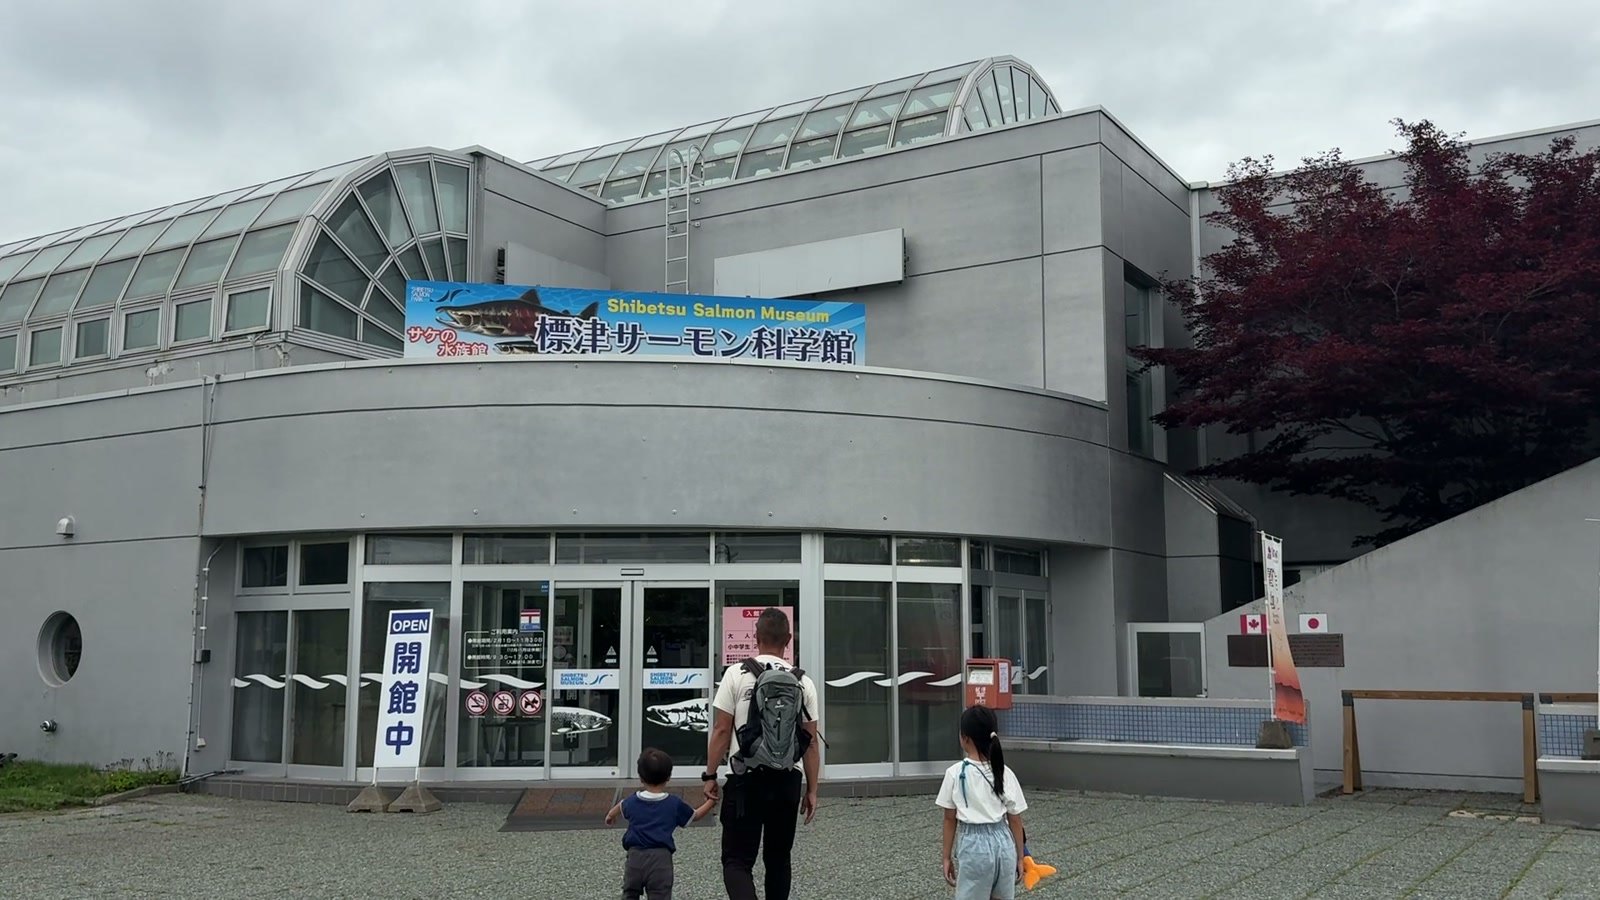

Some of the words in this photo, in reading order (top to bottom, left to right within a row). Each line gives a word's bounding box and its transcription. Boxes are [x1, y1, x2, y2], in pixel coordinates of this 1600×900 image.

[607, 298, 687, 317] Shibetsu
[693, 302, 756, 320] Salmon
[760, 306, 830, 323] Museum
[407, 326, 457, 343] サケの
[535, 314, 857, 365] 標津サーモン科学館
[437, 341, 489, 356] 水族館
[392, 619, 428, 632] OPEN
[385, 641, 422, 755] 開館中
